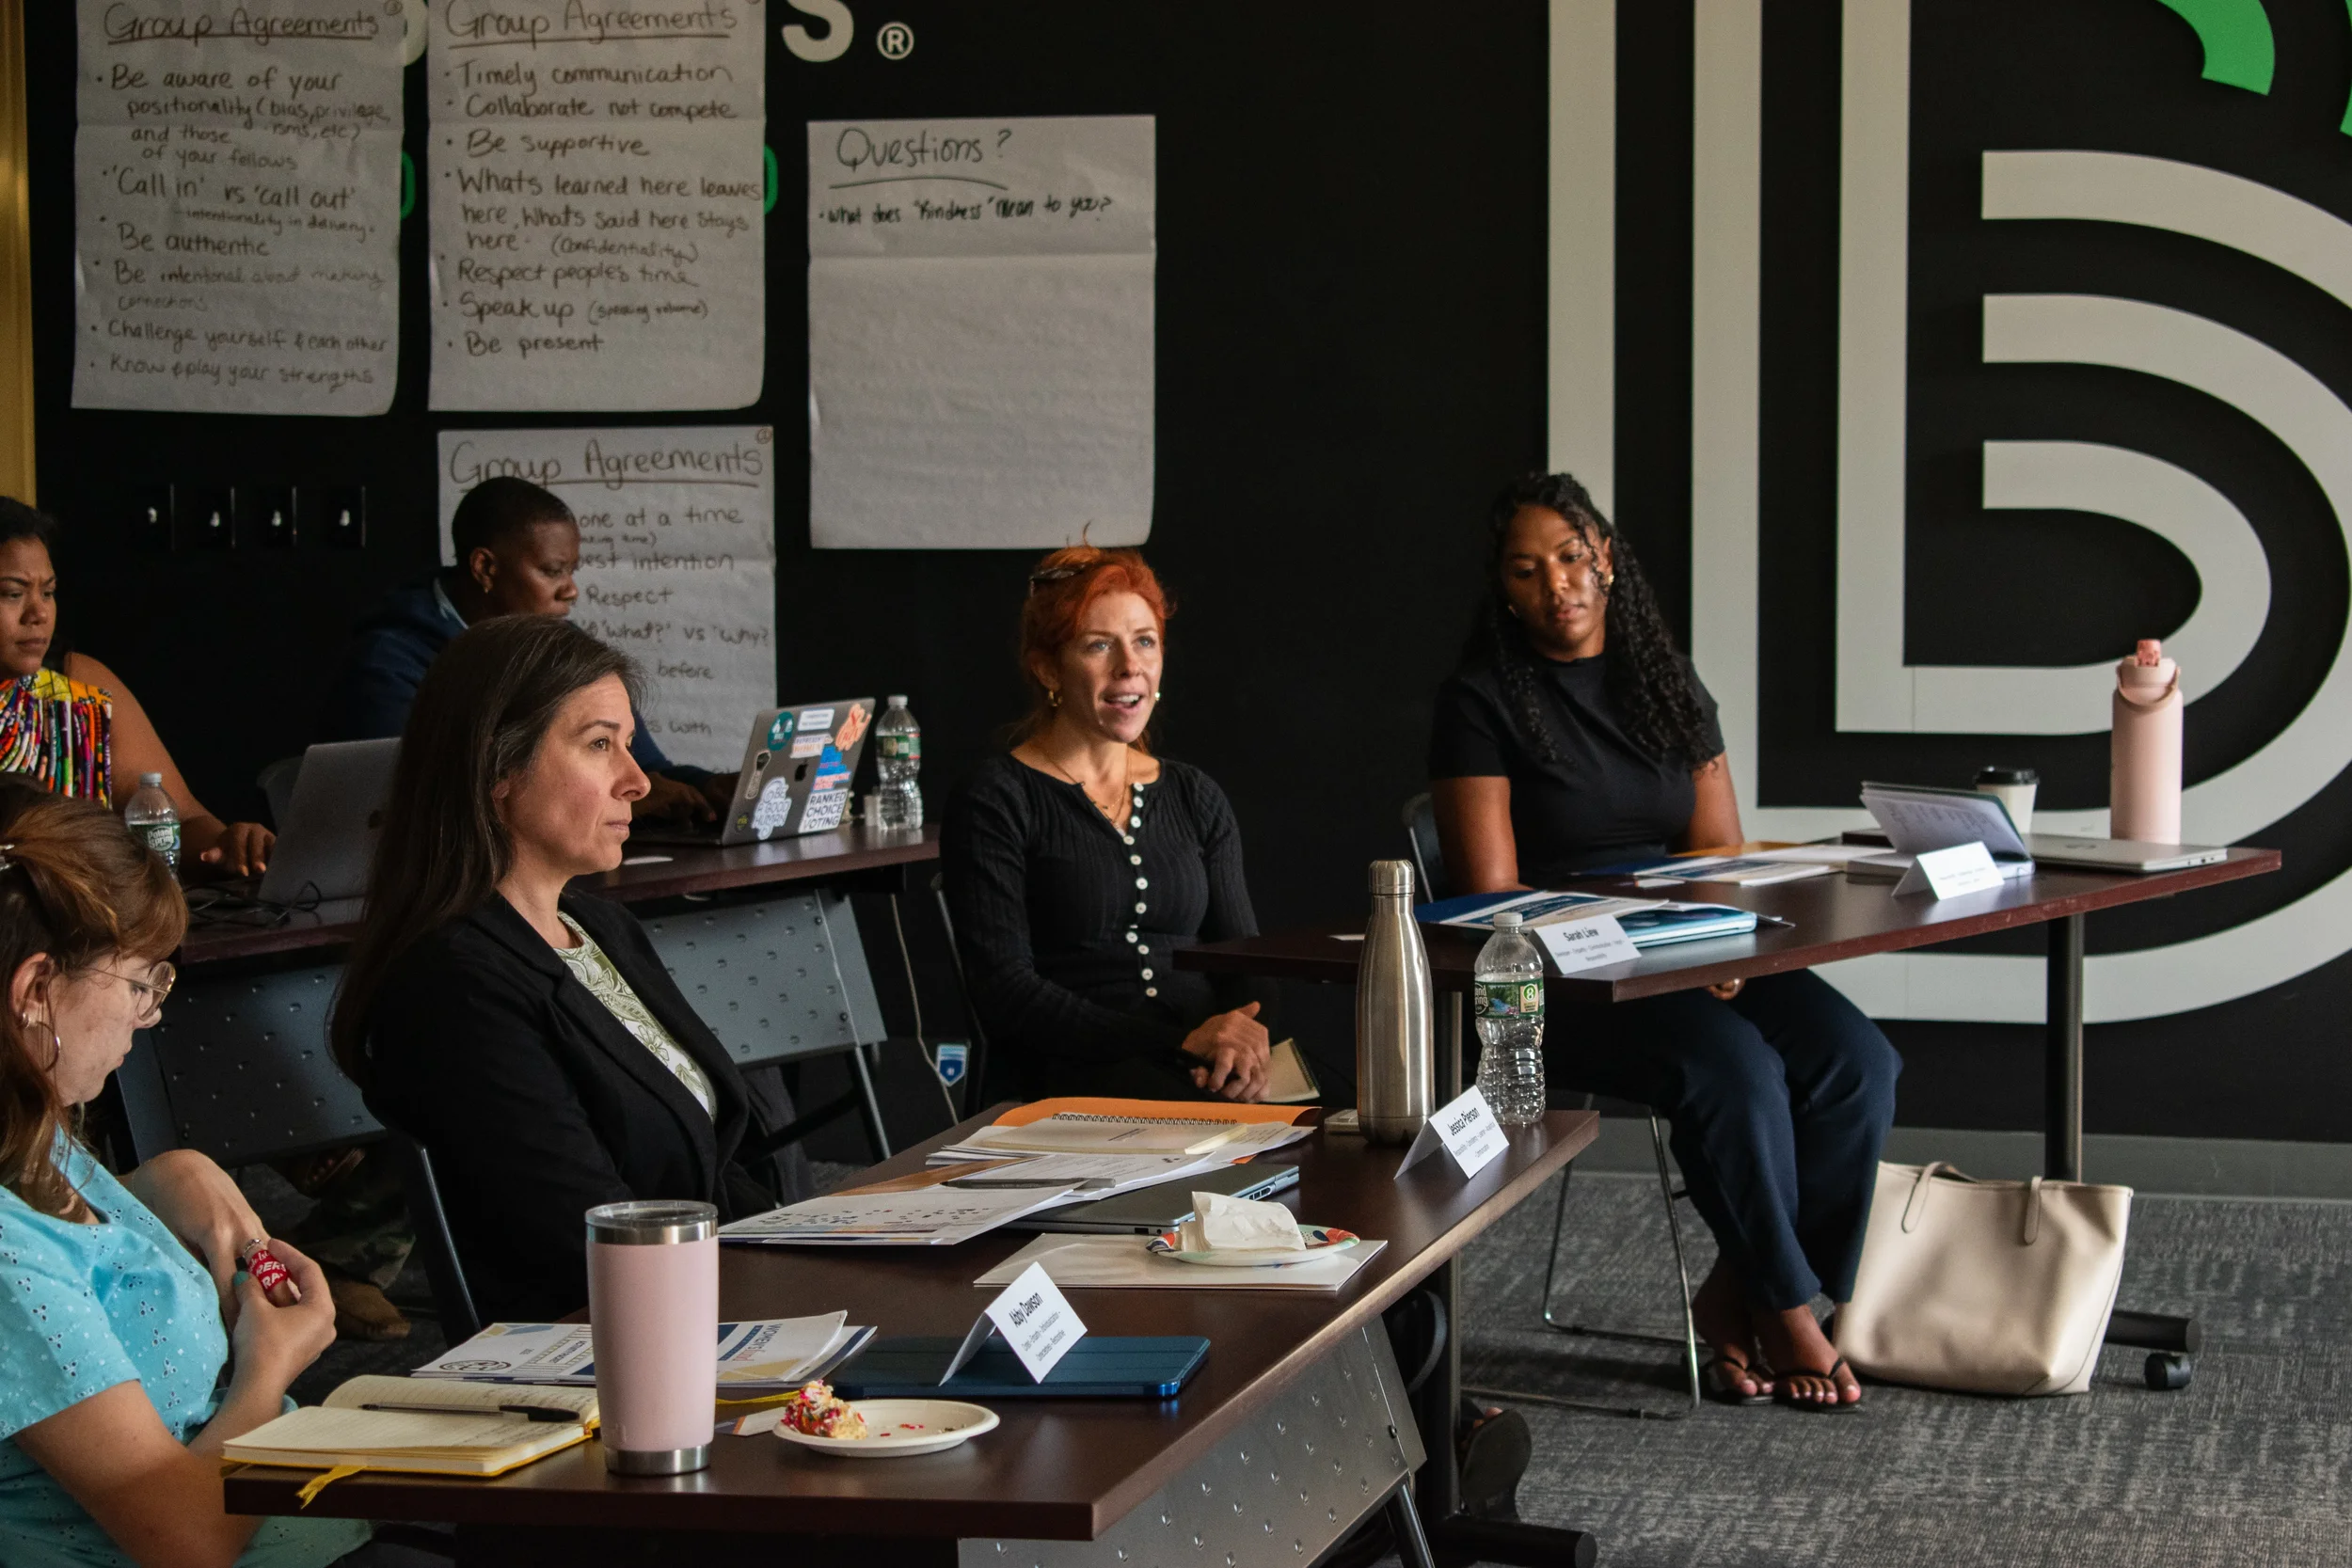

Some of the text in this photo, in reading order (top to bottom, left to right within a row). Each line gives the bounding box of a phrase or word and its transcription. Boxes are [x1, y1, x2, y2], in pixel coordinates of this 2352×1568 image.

[104, 2, 214, 46] Group
[230, 7, 379, 46] Agreements
[445, 0, 738, 50] Group Agreements
[111, 63, 342, 100] Be aware of your
[458, 59, 734, 96] Timely communication
[465, 94, 739, 123] Collaborate not compete
[131, 125, 231, 144] and those
[467, 128, 651, 160] Be supportive
[142, 144, 298, 171] of your fellows
[553, 172, 628, 198] learned
[640, 171, 691, 198] here
[700, 175, 764, 202] leaves
[648, 206, 691, 230] here
[1043, 194, 1059, 213] to
[118, 222, 271, 257] Be authentic
[114, 258, 147, 285] Be
[458, 257, 547, 290] Respect
[639, 263, 700, 288] time
[459, 291, 540, 325] Speak
[543, 300, 576, 328] up
[108, 318, 199, 355] Challenge
[204, 330, 287, 353] yourself
[308, 332, 342, 350] each
[345, 335, 388, 353] other
[465, 330, 605, 360] Be present
[110, 353, 166, 374] Know
[228, 365, 271, 387] your
[278, 365, 374, 394] strengths
[583, 438, 764, 491] Agreements
[580, 504, 745, 528] one at a time
[632, 552, 735, 572] intention
[584, 586, 675, 610] Respect
[683, 626, 706, 641] vs
[659, 658, 715, 680] before
[806, 802, 844, 818] CHOICE
[809, 791, 847, 806] RANKED
[803, 816, 840, 830] VOTING
[1562, 926, 1600, 942] Sarah Liew
[1447, 1106, 1481, 1137] Jessica Pierson
[1008, 1291, 1044, 1328] Abby Dawson
